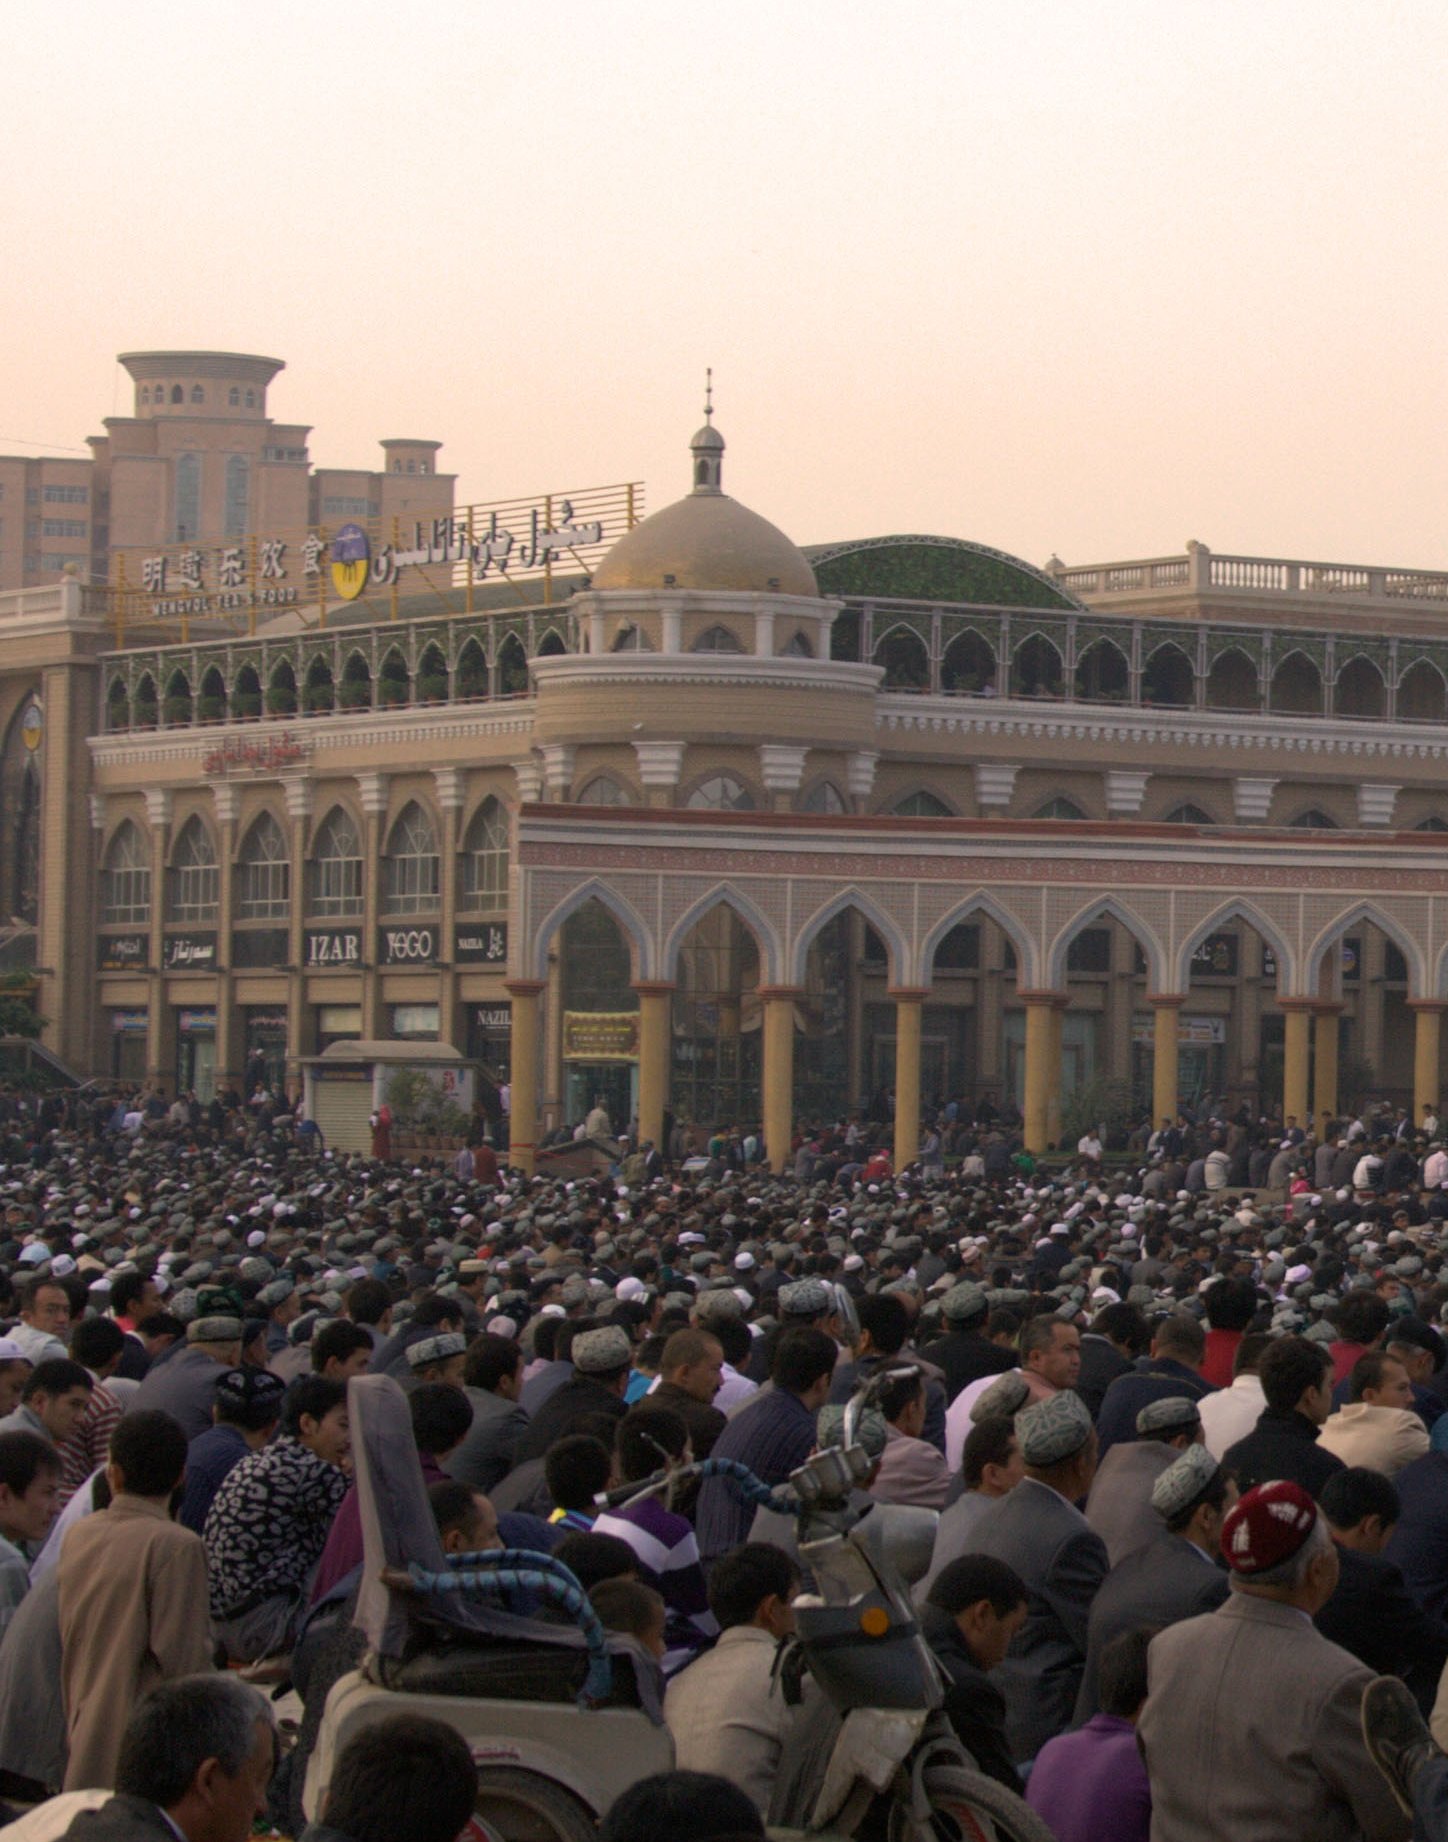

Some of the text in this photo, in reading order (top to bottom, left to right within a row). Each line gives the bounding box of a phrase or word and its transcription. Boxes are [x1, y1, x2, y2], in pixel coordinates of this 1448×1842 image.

[217, 593, 242, 608] TEA
[261, 586, 297, 604] FOOD
[310, 935, 359, 960] IZAR
[386, 931, 432, 958] YOGO
